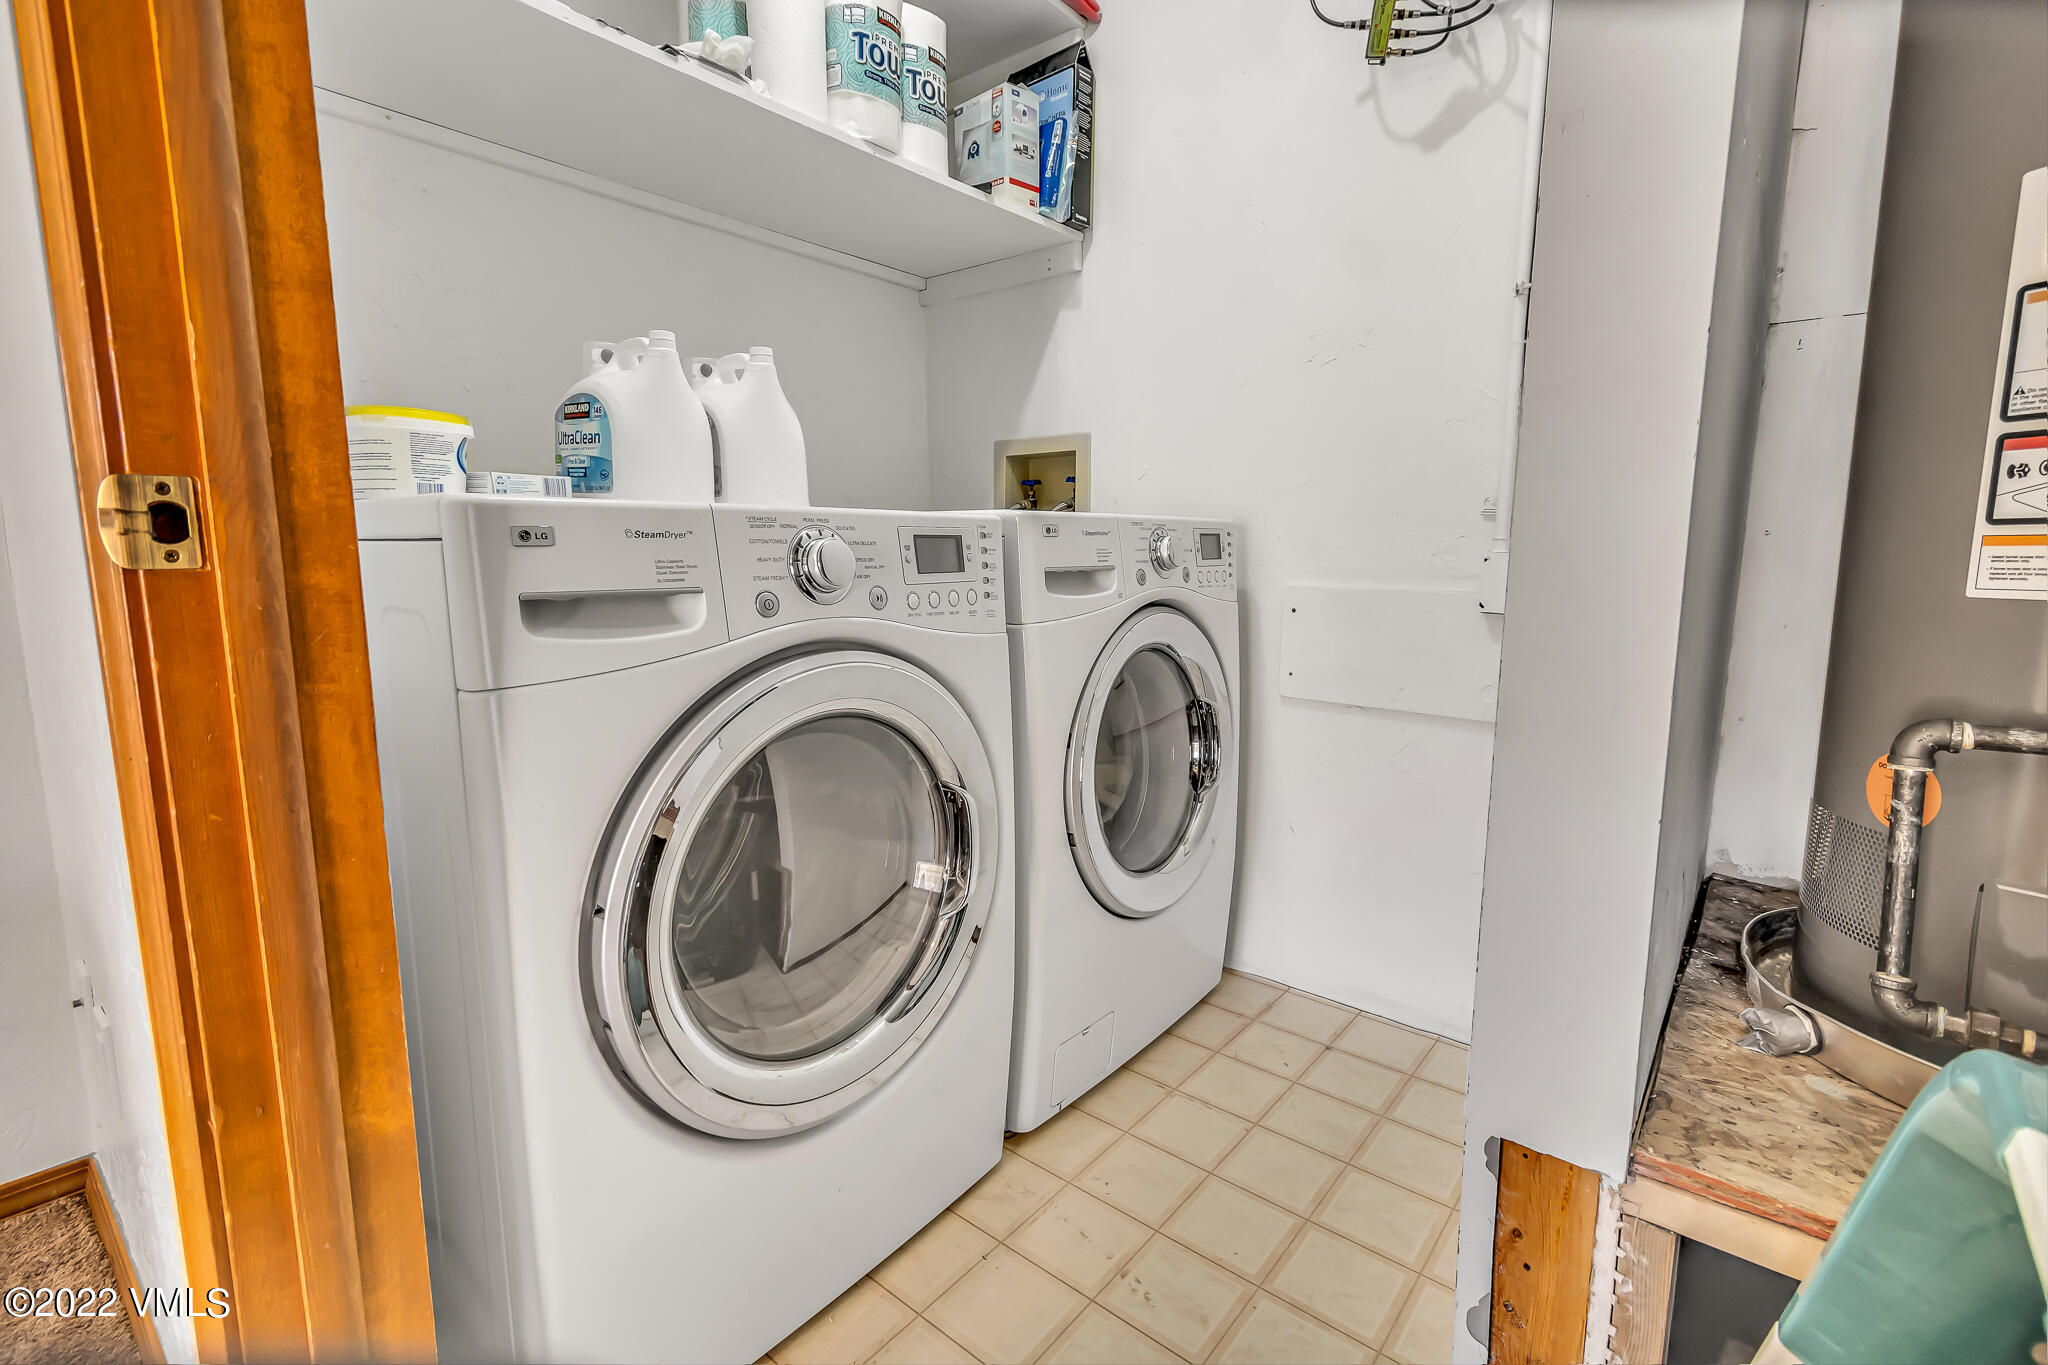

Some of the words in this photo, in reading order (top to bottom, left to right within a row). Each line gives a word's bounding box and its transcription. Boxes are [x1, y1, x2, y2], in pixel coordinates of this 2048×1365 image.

[1047, 84, 1068, 98] Home
[565, 403, 589, 414] KIRKLAND
[558, 430, 601, 445] UltraClean
[534, 532, 548, 540] LG
[633, 530, 693, 540] SteamDryer™
